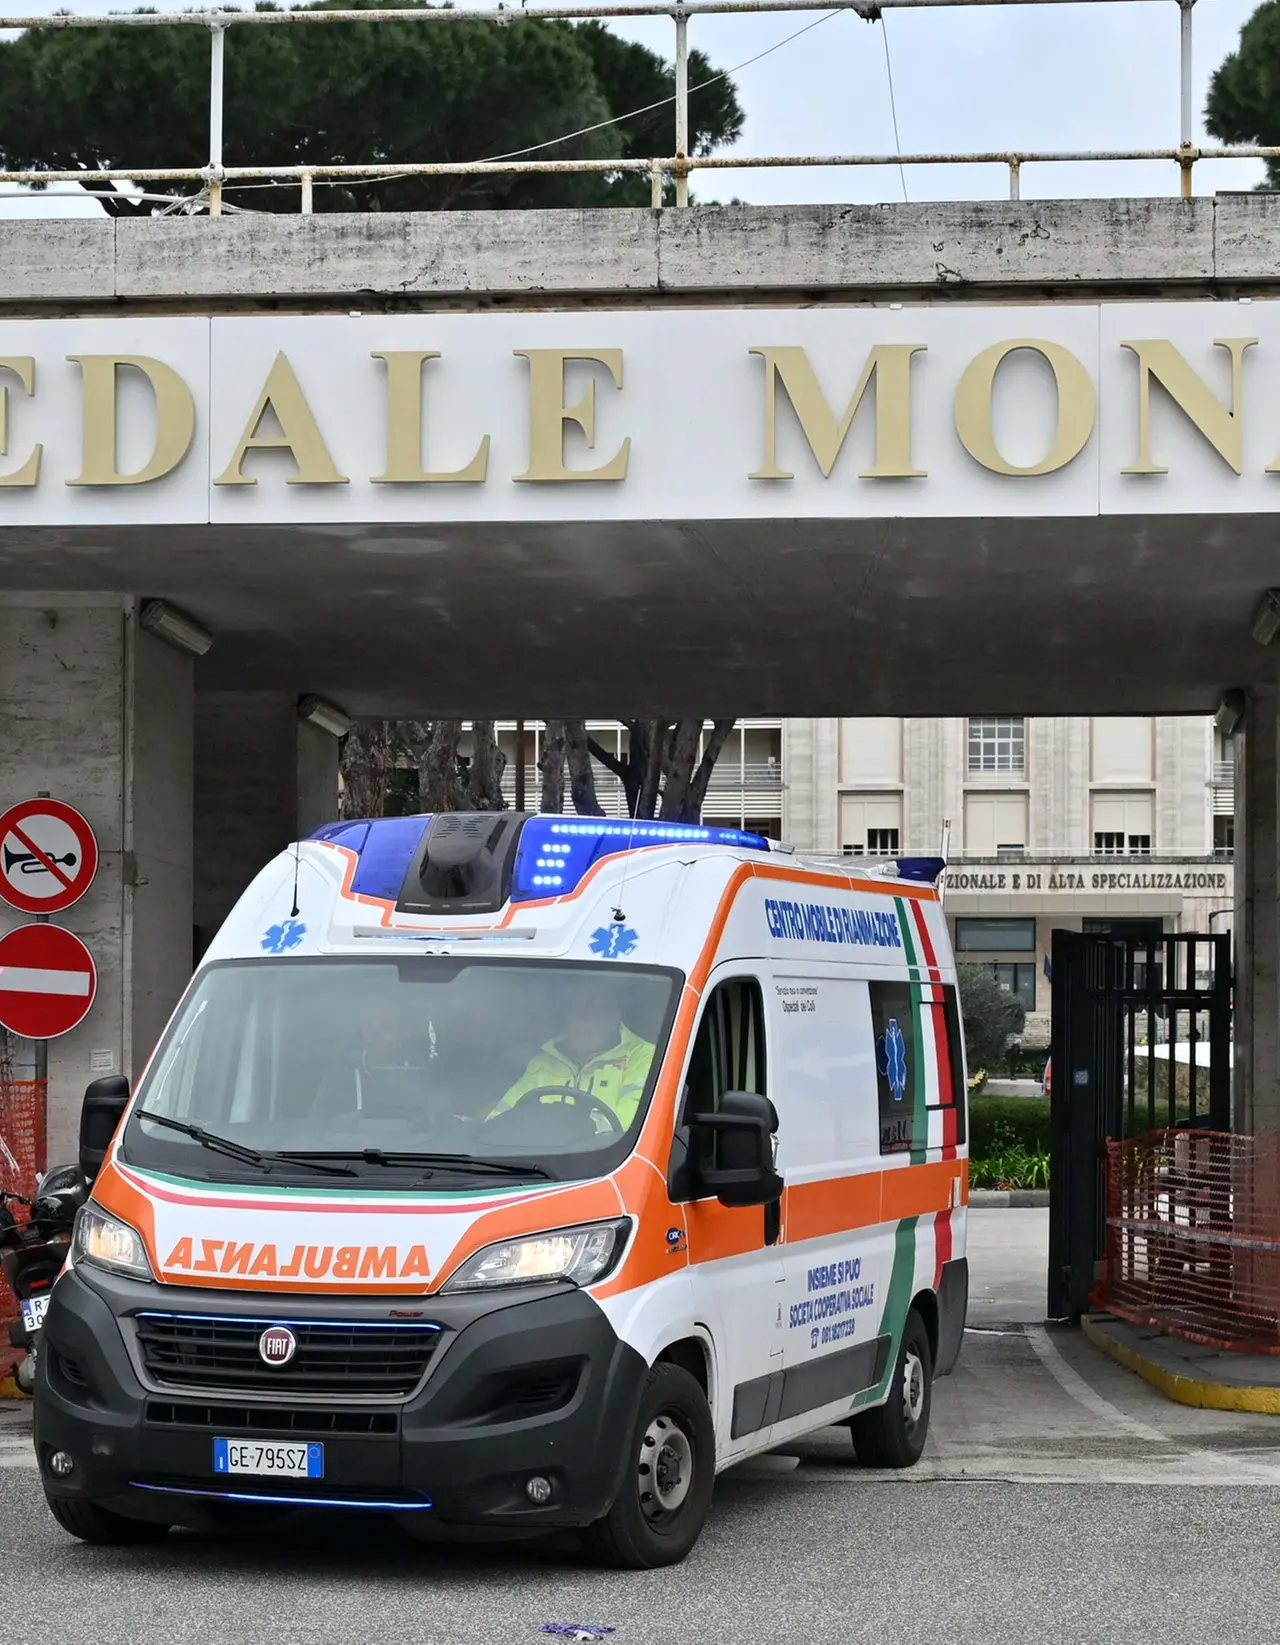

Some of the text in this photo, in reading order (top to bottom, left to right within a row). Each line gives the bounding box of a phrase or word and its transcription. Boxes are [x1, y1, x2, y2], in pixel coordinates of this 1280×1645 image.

[947, 873, 1227, 889] ZIONALE E DI ALTA SPECIALIZZAZIONE
[765, 899, 804, 940] CENTRO
[801, 903, 837, 943] MOBILE
[808, 1263, 837, 1292] INSIEME
[837, 1261, 844, 1284] SI
[389, 1310, 424, 1318] Power
[267, 1338, 287, 1355] FIAT
